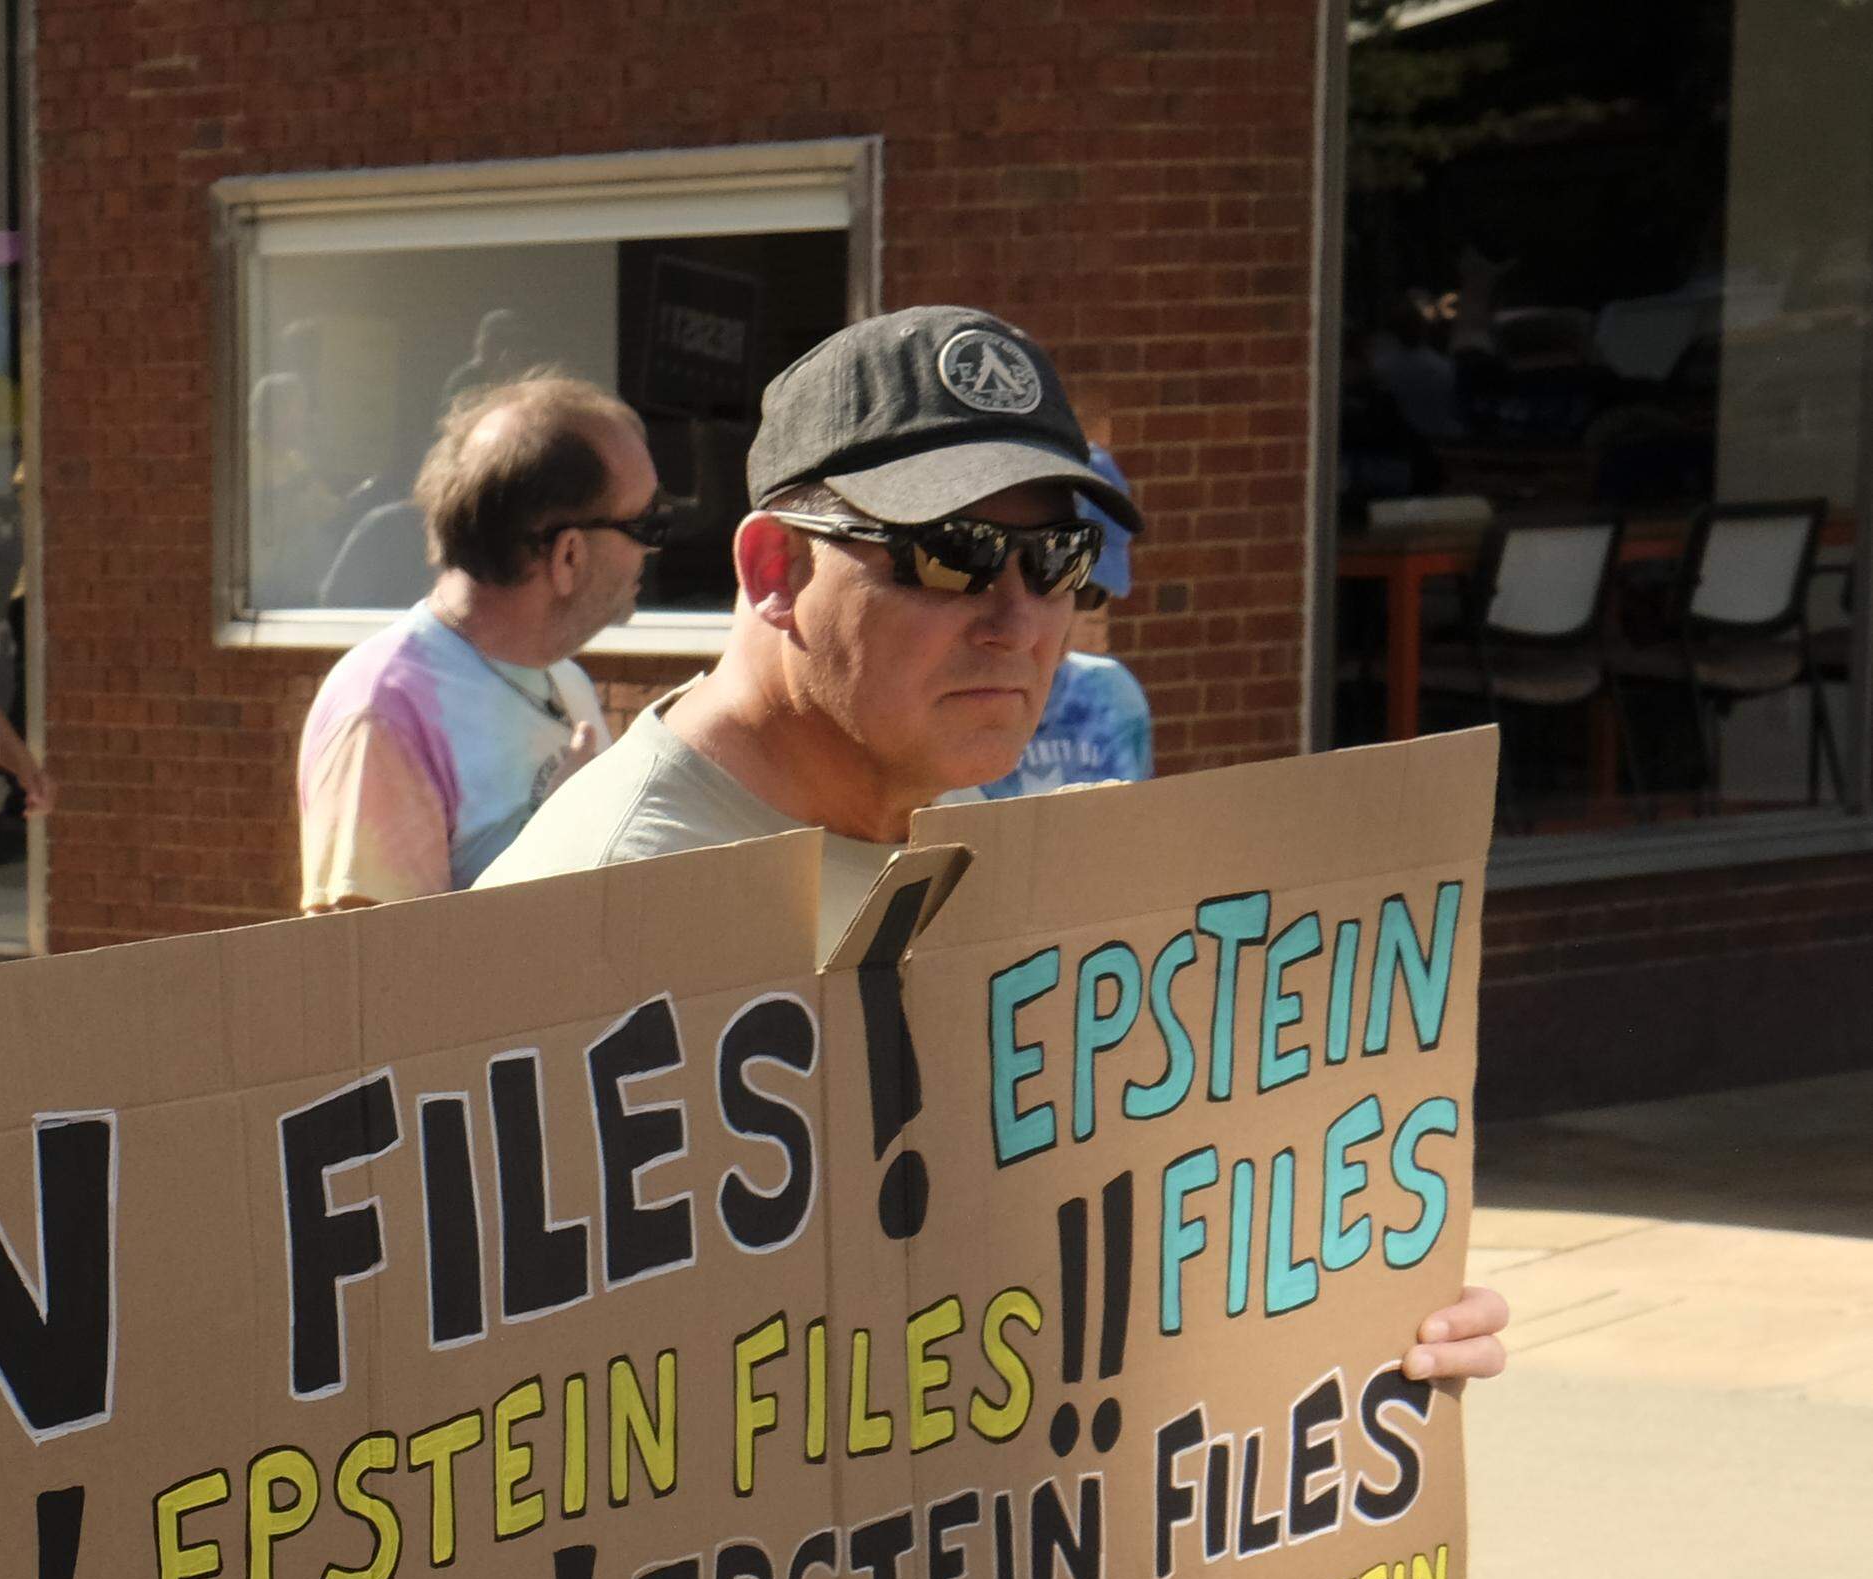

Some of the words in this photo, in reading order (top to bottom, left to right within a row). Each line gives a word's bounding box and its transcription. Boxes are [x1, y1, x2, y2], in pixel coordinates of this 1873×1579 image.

[277, 877, 932, 1402] FILES!
[989, 880, 1463, 1169] EPSTEIN
[1158, 1094, 1458, 1336] FILES
